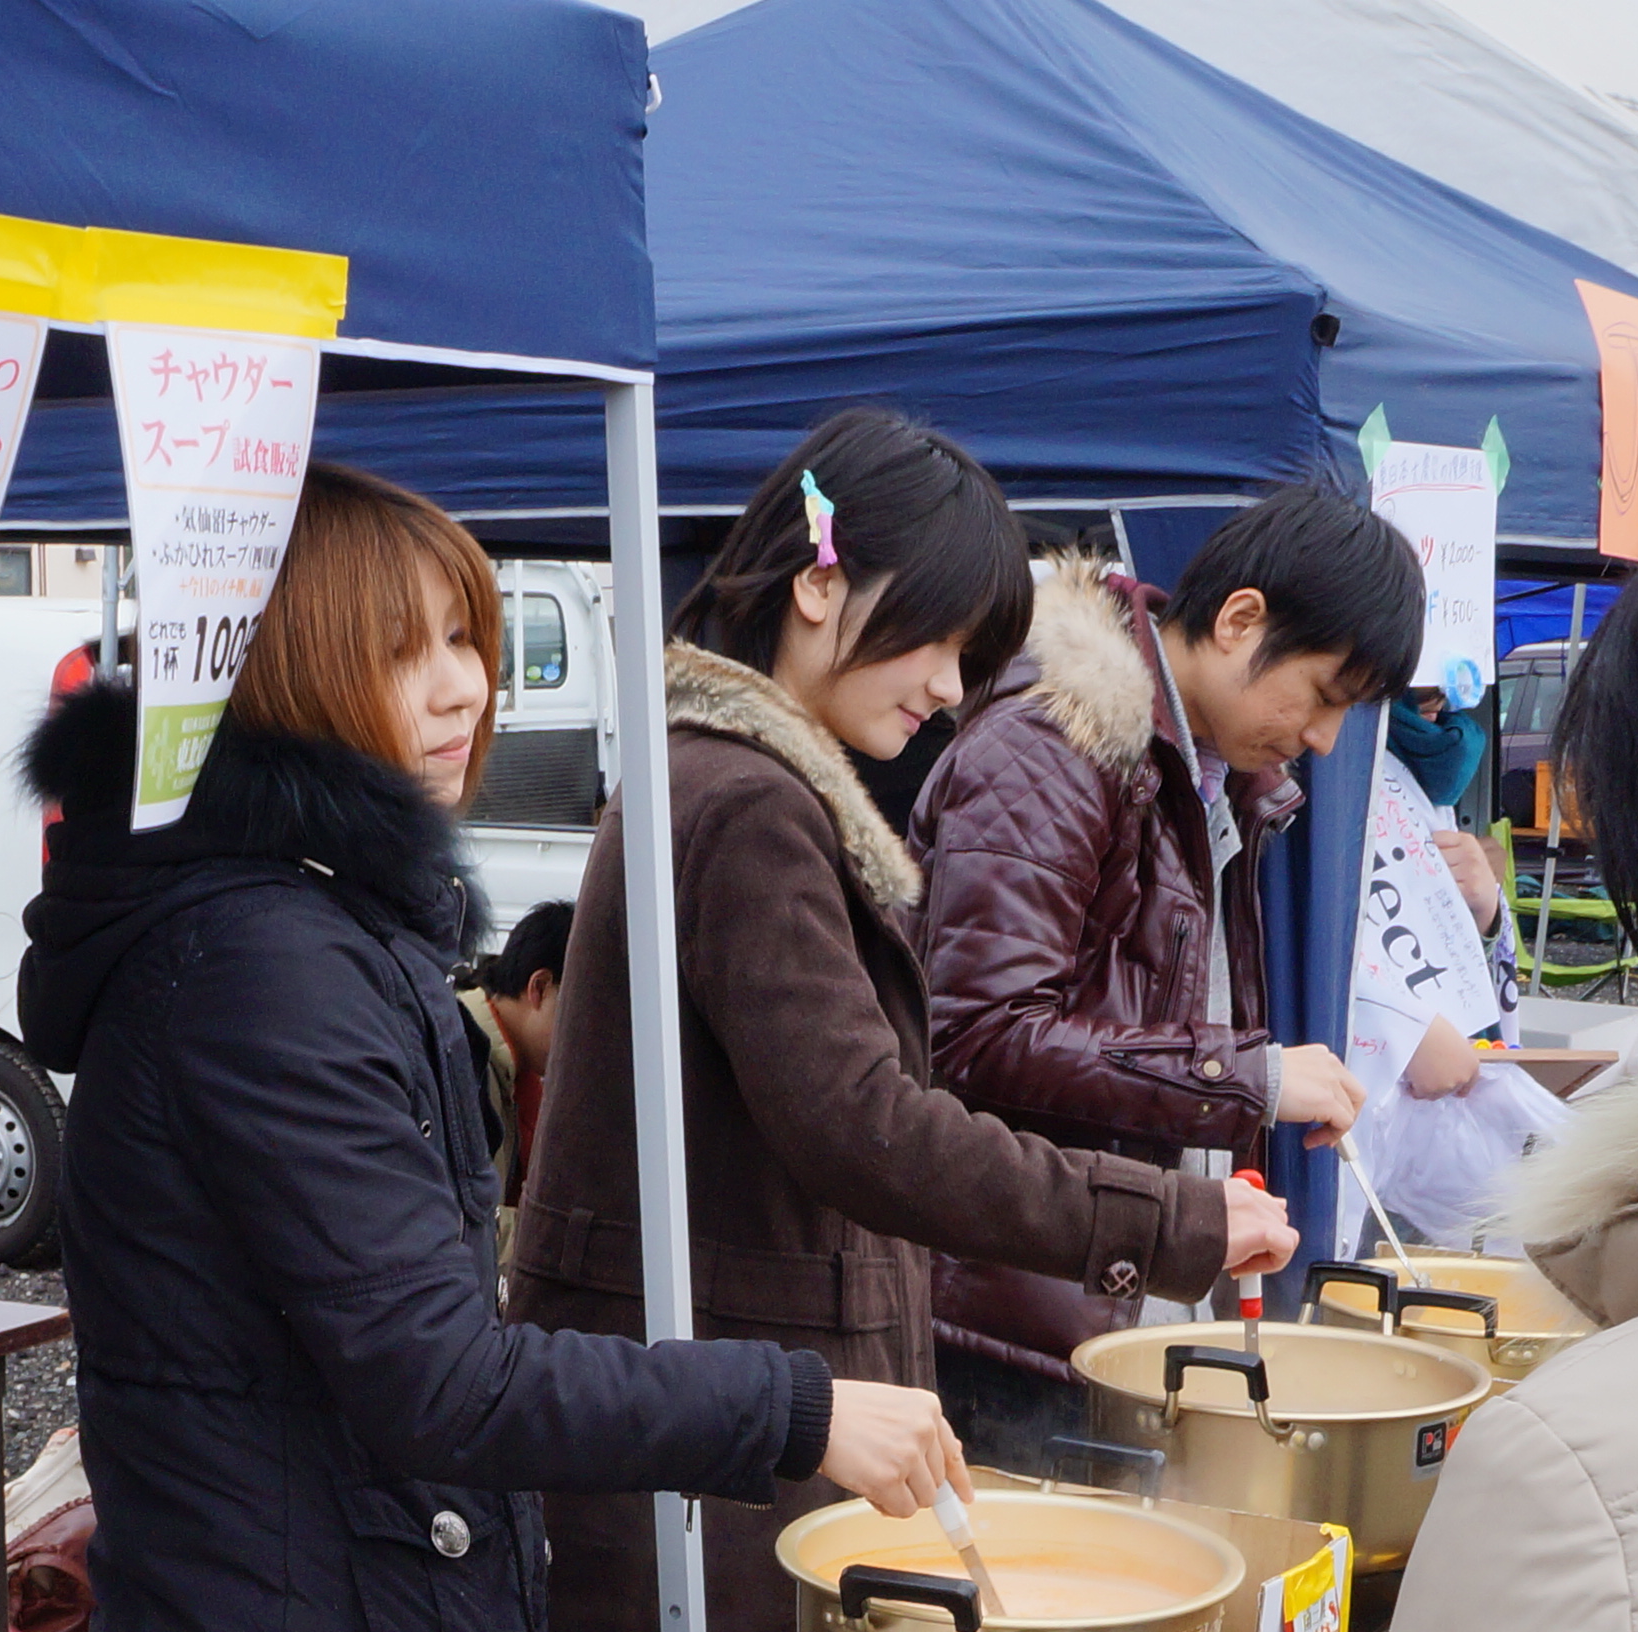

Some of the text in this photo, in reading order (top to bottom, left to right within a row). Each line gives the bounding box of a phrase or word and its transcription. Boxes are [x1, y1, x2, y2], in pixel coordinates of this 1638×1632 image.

[148, 347, 294, 405] チャウダー
[141, 418, 301, 478] スープ 試食販売
[152, 646, 180, 682] 1杯
